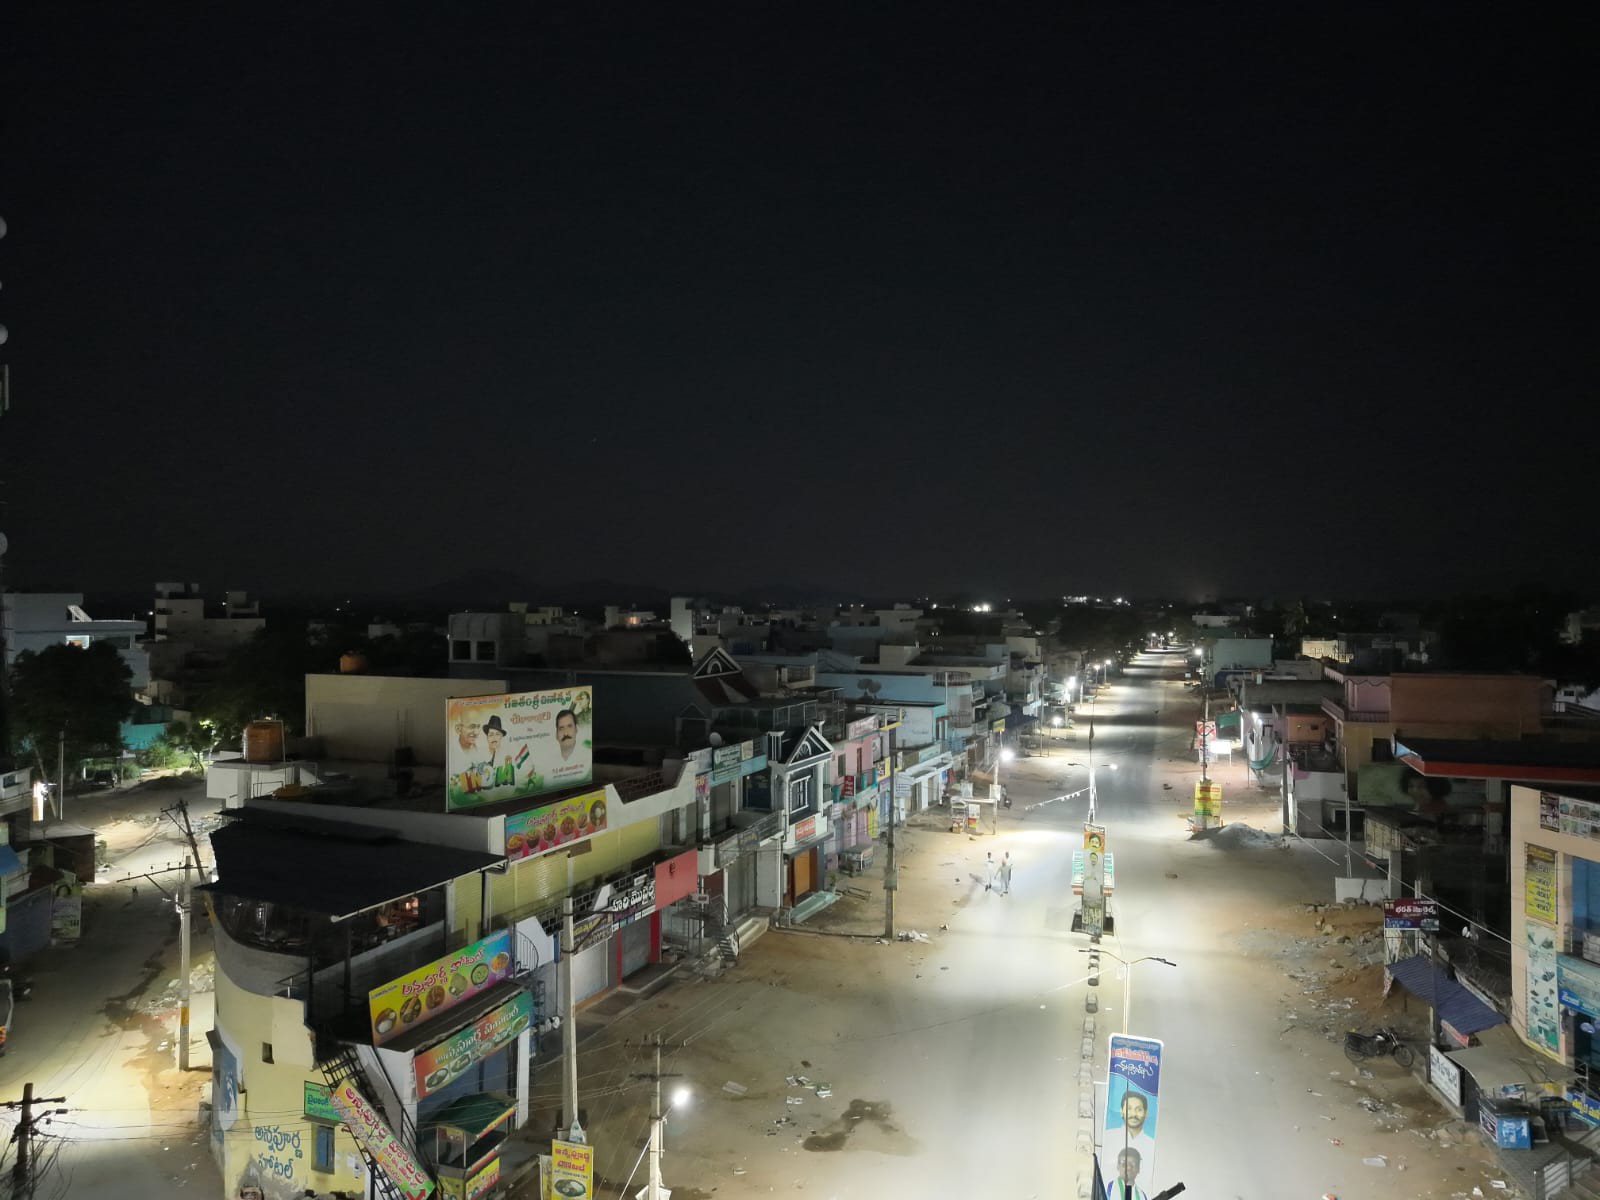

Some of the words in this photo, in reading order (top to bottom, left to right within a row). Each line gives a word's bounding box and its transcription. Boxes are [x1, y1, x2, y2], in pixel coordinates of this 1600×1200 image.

[402, 966, 448, 996] అన్నపూర్ణ
[345, 1087, 389, 1143] అన్నపూర్ణ
[255, 1125, 303, 1159] అన్నపూర్ణ
[554, 1148, 590, 1163] అన్నపూర్ణ
[258, 1152, 294, 1179] హోటల్
